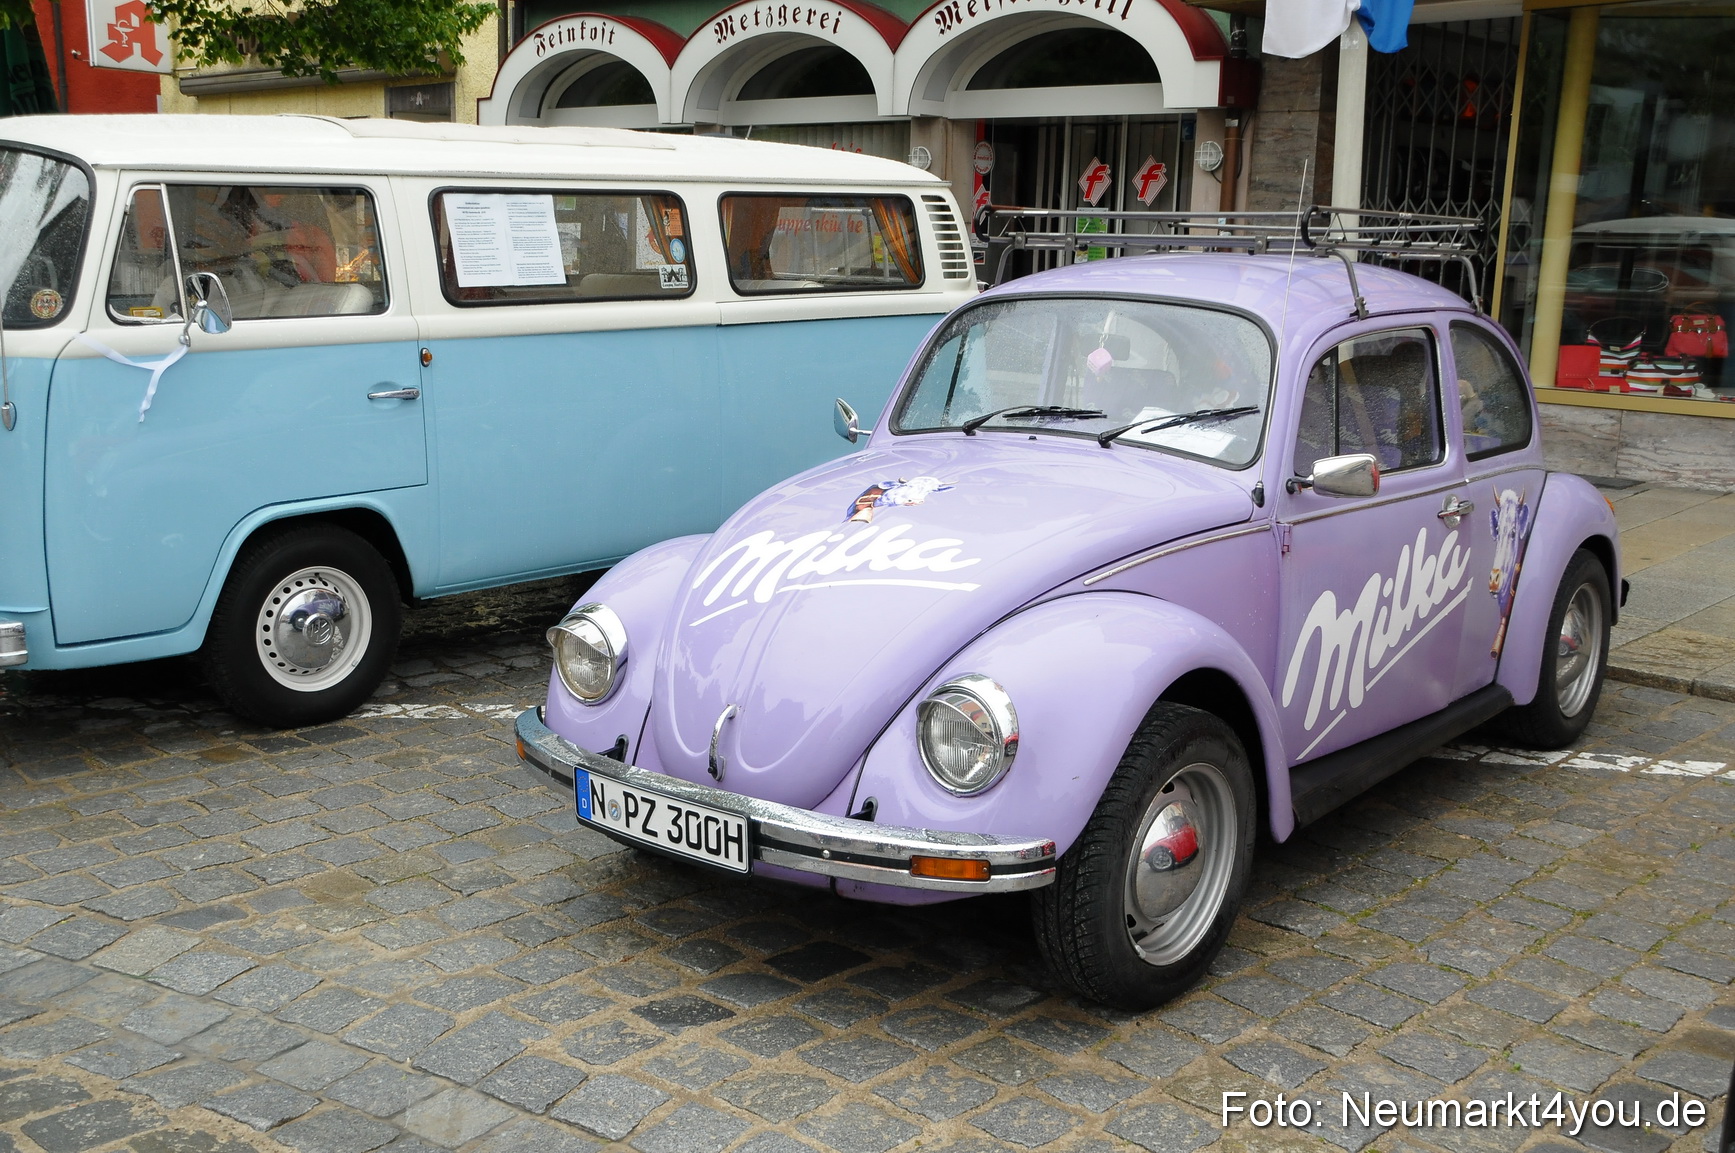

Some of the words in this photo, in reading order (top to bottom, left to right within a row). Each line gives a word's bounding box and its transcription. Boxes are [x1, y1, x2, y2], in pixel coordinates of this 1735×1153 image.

[713, 4, 842, 44] Metzgerei
[692, 523, 982, 604] Milka
[1282, 527, 1471, 731] Milka
[590, 778, 606, 820] N
[622, 790, 659, 838] PZ
[666, 804, 745, 863] 300H
